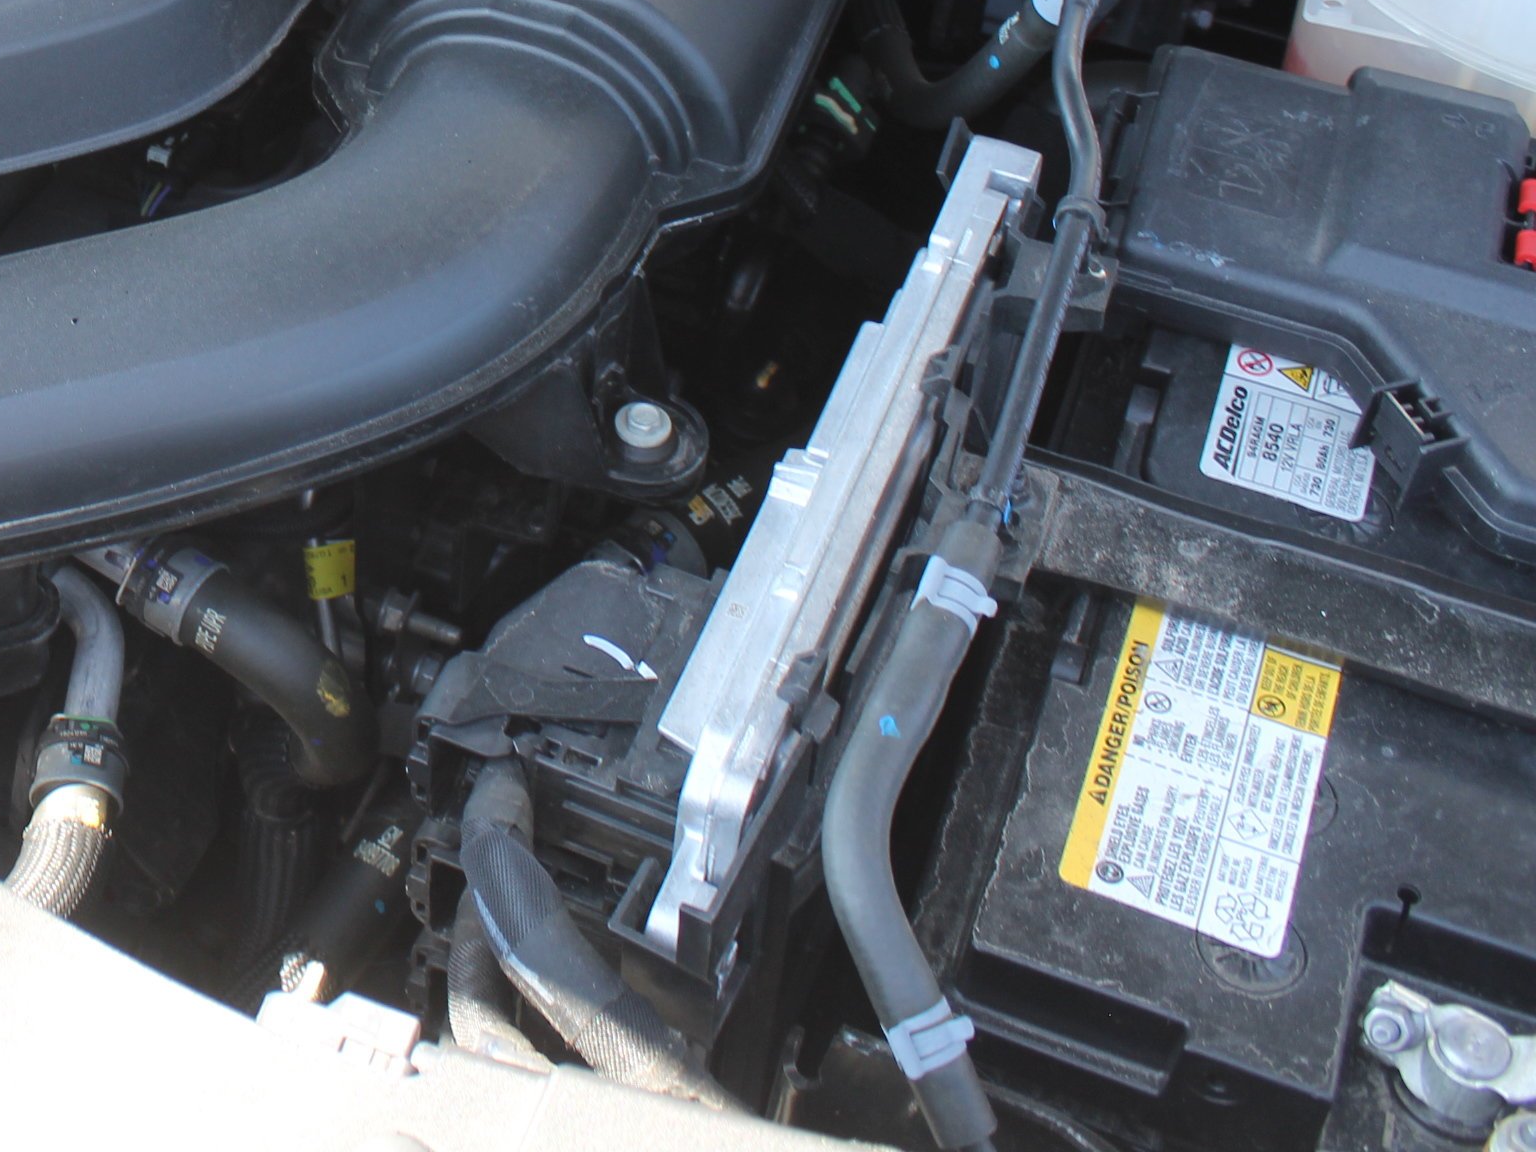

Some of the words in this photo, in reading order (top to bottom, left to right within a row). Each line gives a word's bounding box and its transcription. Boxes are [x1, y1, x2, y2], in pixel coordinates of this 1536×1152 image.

[1210, 383, 1248, 471] ACDelco
[1283, 421, 1302, 452] VRLA
[1322, 418, 1335, 437] 730
[1261, 421, 1284, 462] 8540
[1279, 453, 1295, 473] 12V
[1308, 475, 1322, 497] 730
[1091, 639, 1149, 788] DANGER/POISON
[1117, 814, 1142, 864] EXPLOSIVE
[1130, 783, 1150, 815] GASES
[1166, 840, 1182, 859] LES
[1173, 872, 1189, 893] GAZ
[1168, 892, 1184, 911] LES
